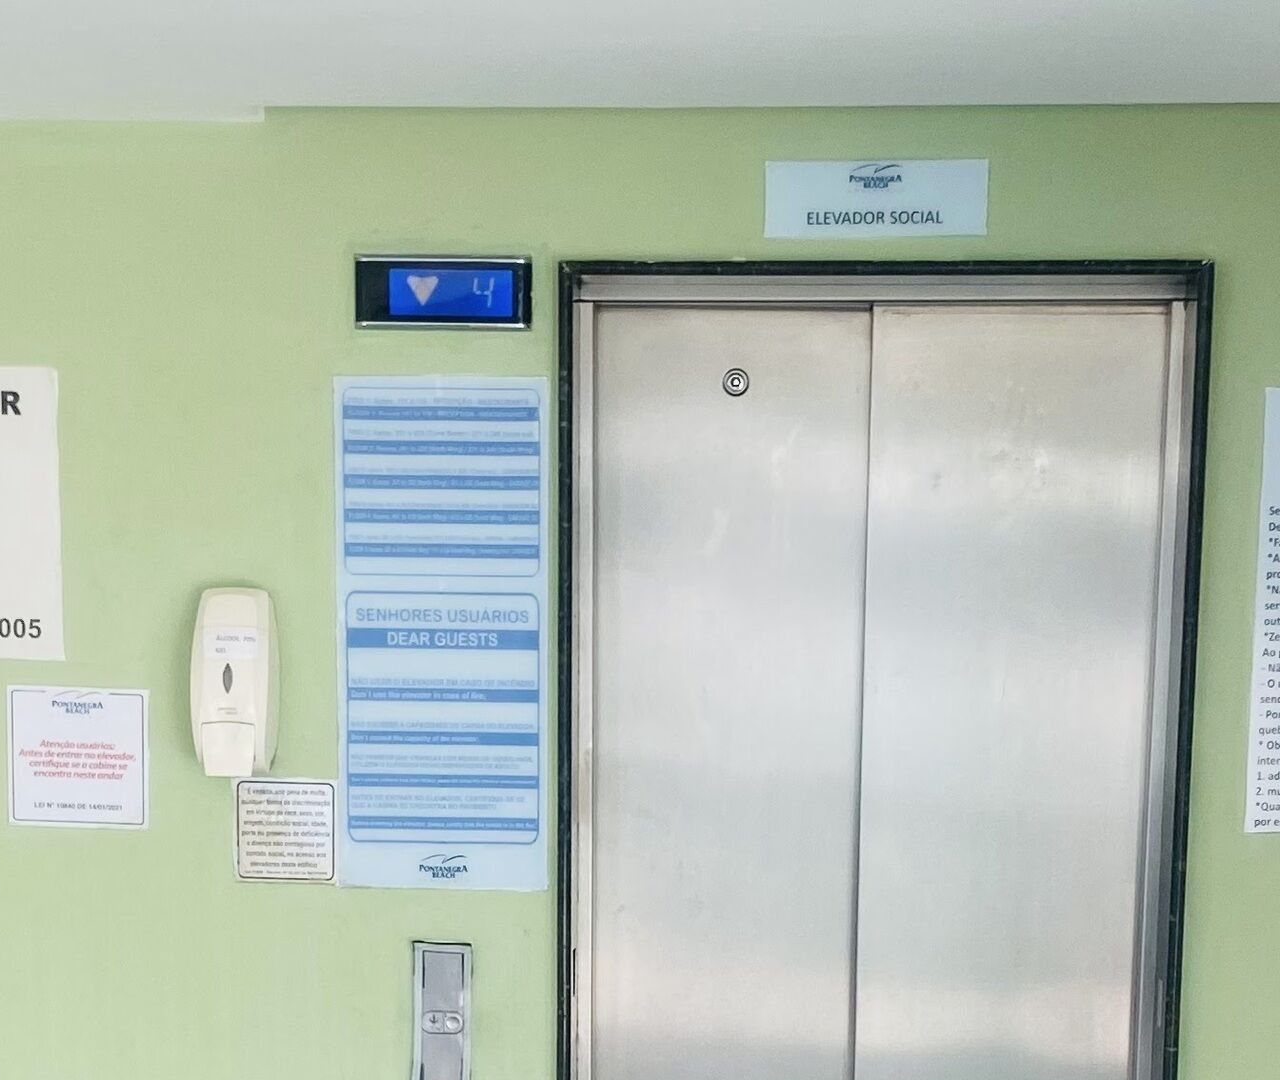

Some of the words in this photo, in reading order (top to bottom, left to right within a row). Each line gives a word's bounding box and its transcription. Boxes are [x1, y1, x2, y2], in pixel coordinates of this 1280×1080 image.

[850, 174, 902, 183] PONTANEGRA
[807, 211, 884, 225] ELEVADOR
[890, 210, 944, 225] SOCIAL
[473, 278, 495, 308] 4
[356, 608, 442, 623] SENHORES
[448, 608, 529, 624] USUÁRIOS
[387, 632, 431, 646] DEAR
[435, 632, 498, 647] GUESTS
[1262, 648, 1276, 657] Ao
[44, 750, 55, 758] de
[1255, 819, 1271, 828] por
[419, 864, 468, 873] PONTANEGRA
